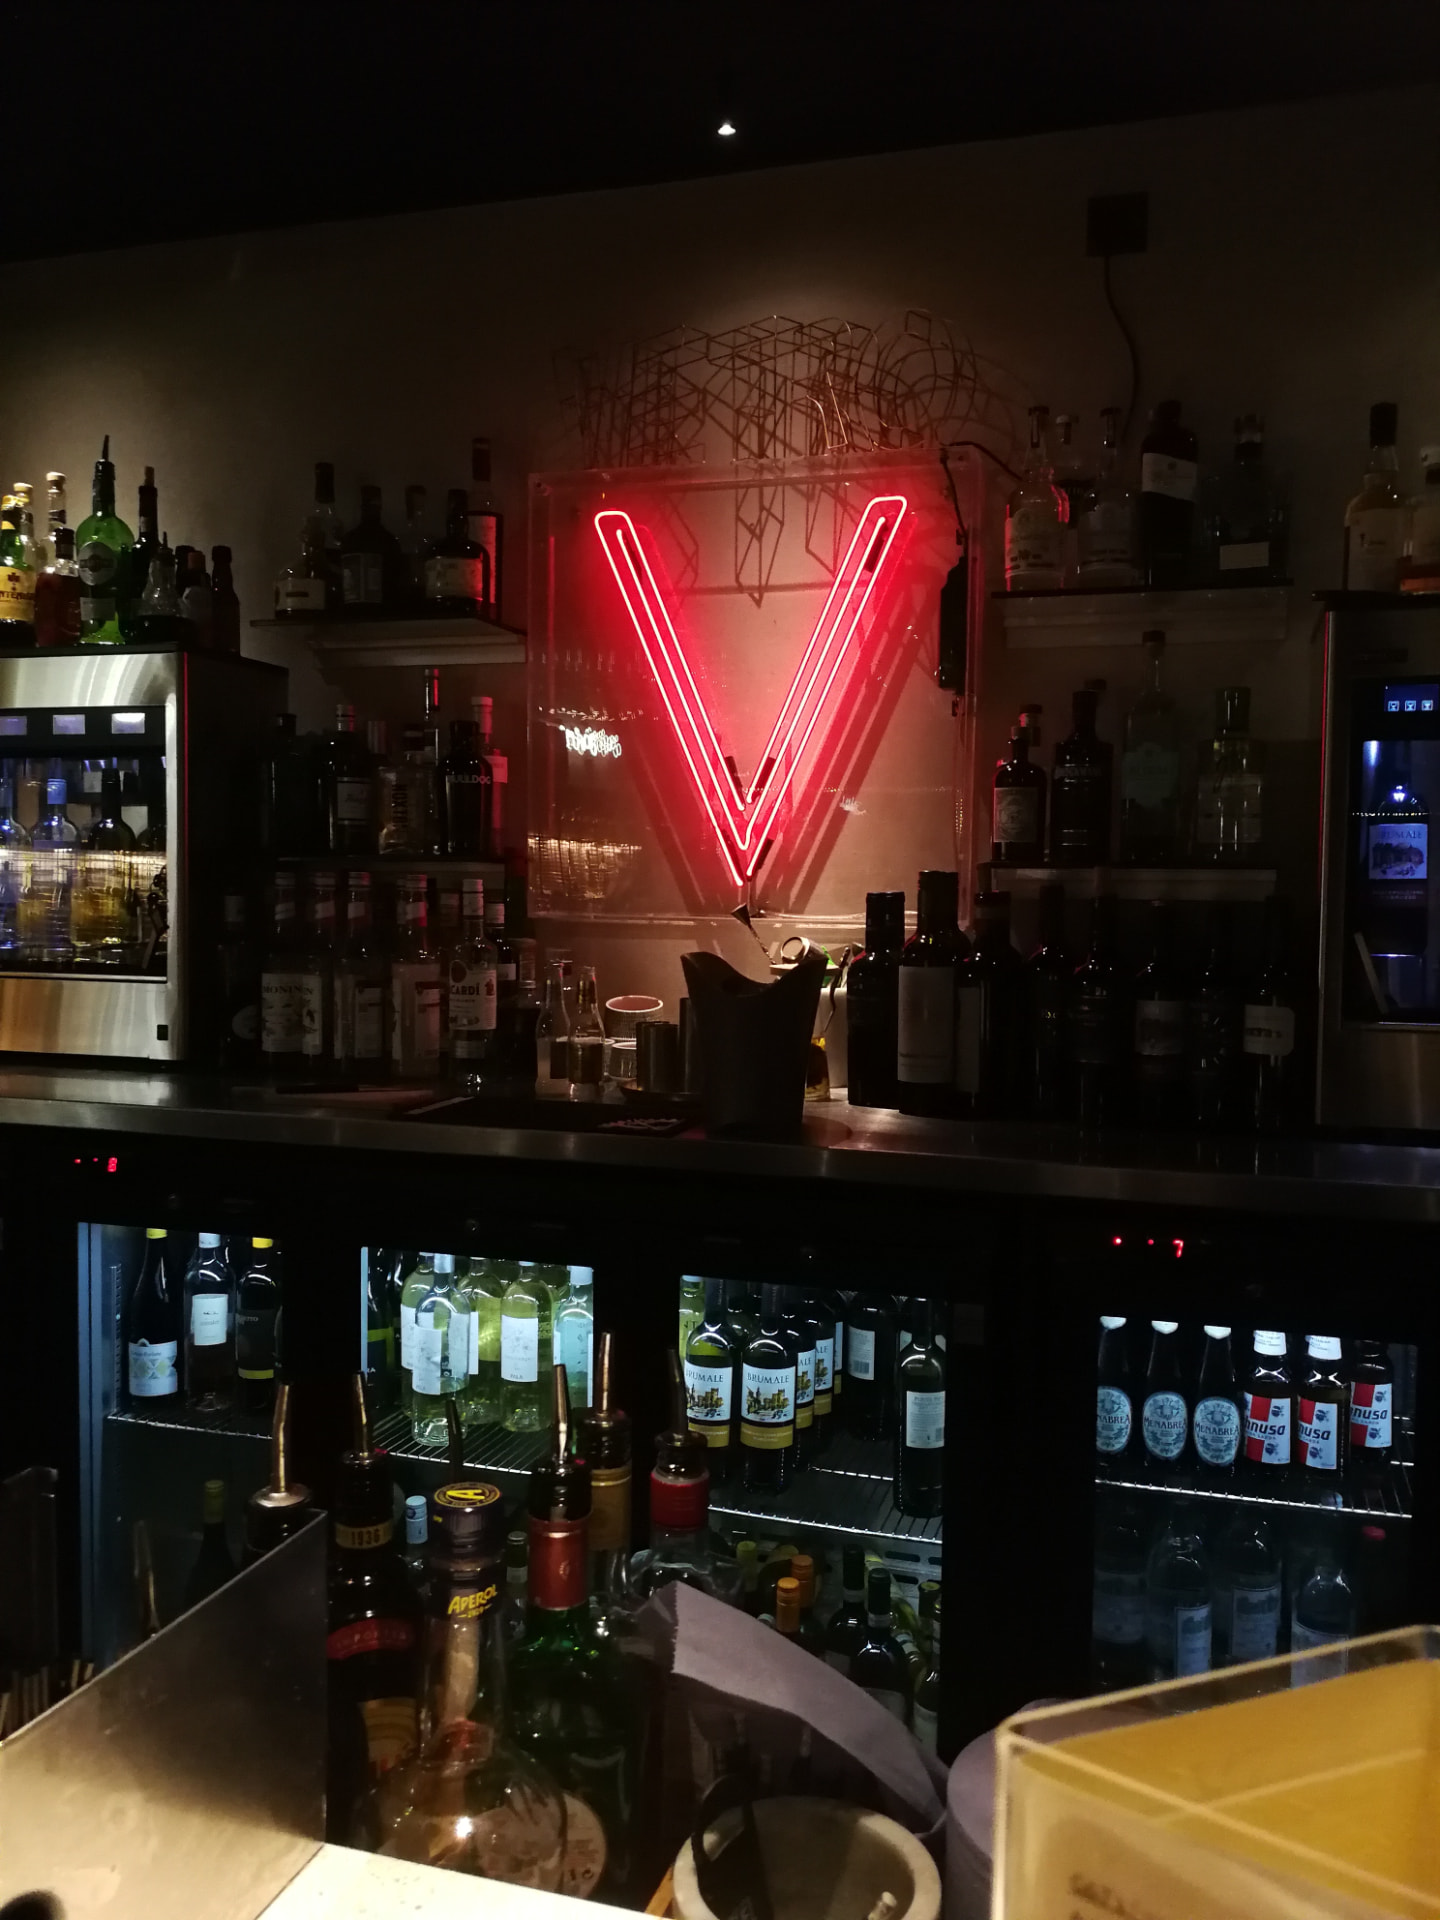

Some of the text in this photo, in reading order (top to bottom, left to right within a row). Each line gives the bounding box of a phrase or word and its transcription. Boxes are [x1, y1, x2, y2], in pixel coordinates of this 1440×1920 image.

[747, 1372, 790, 1384] BRUMALE
[1195, 1421, 1239, 1436] MENABREA
[351, 1528, 380, 1546] 1936
[447, 1584, 498, 1615] APEROL
